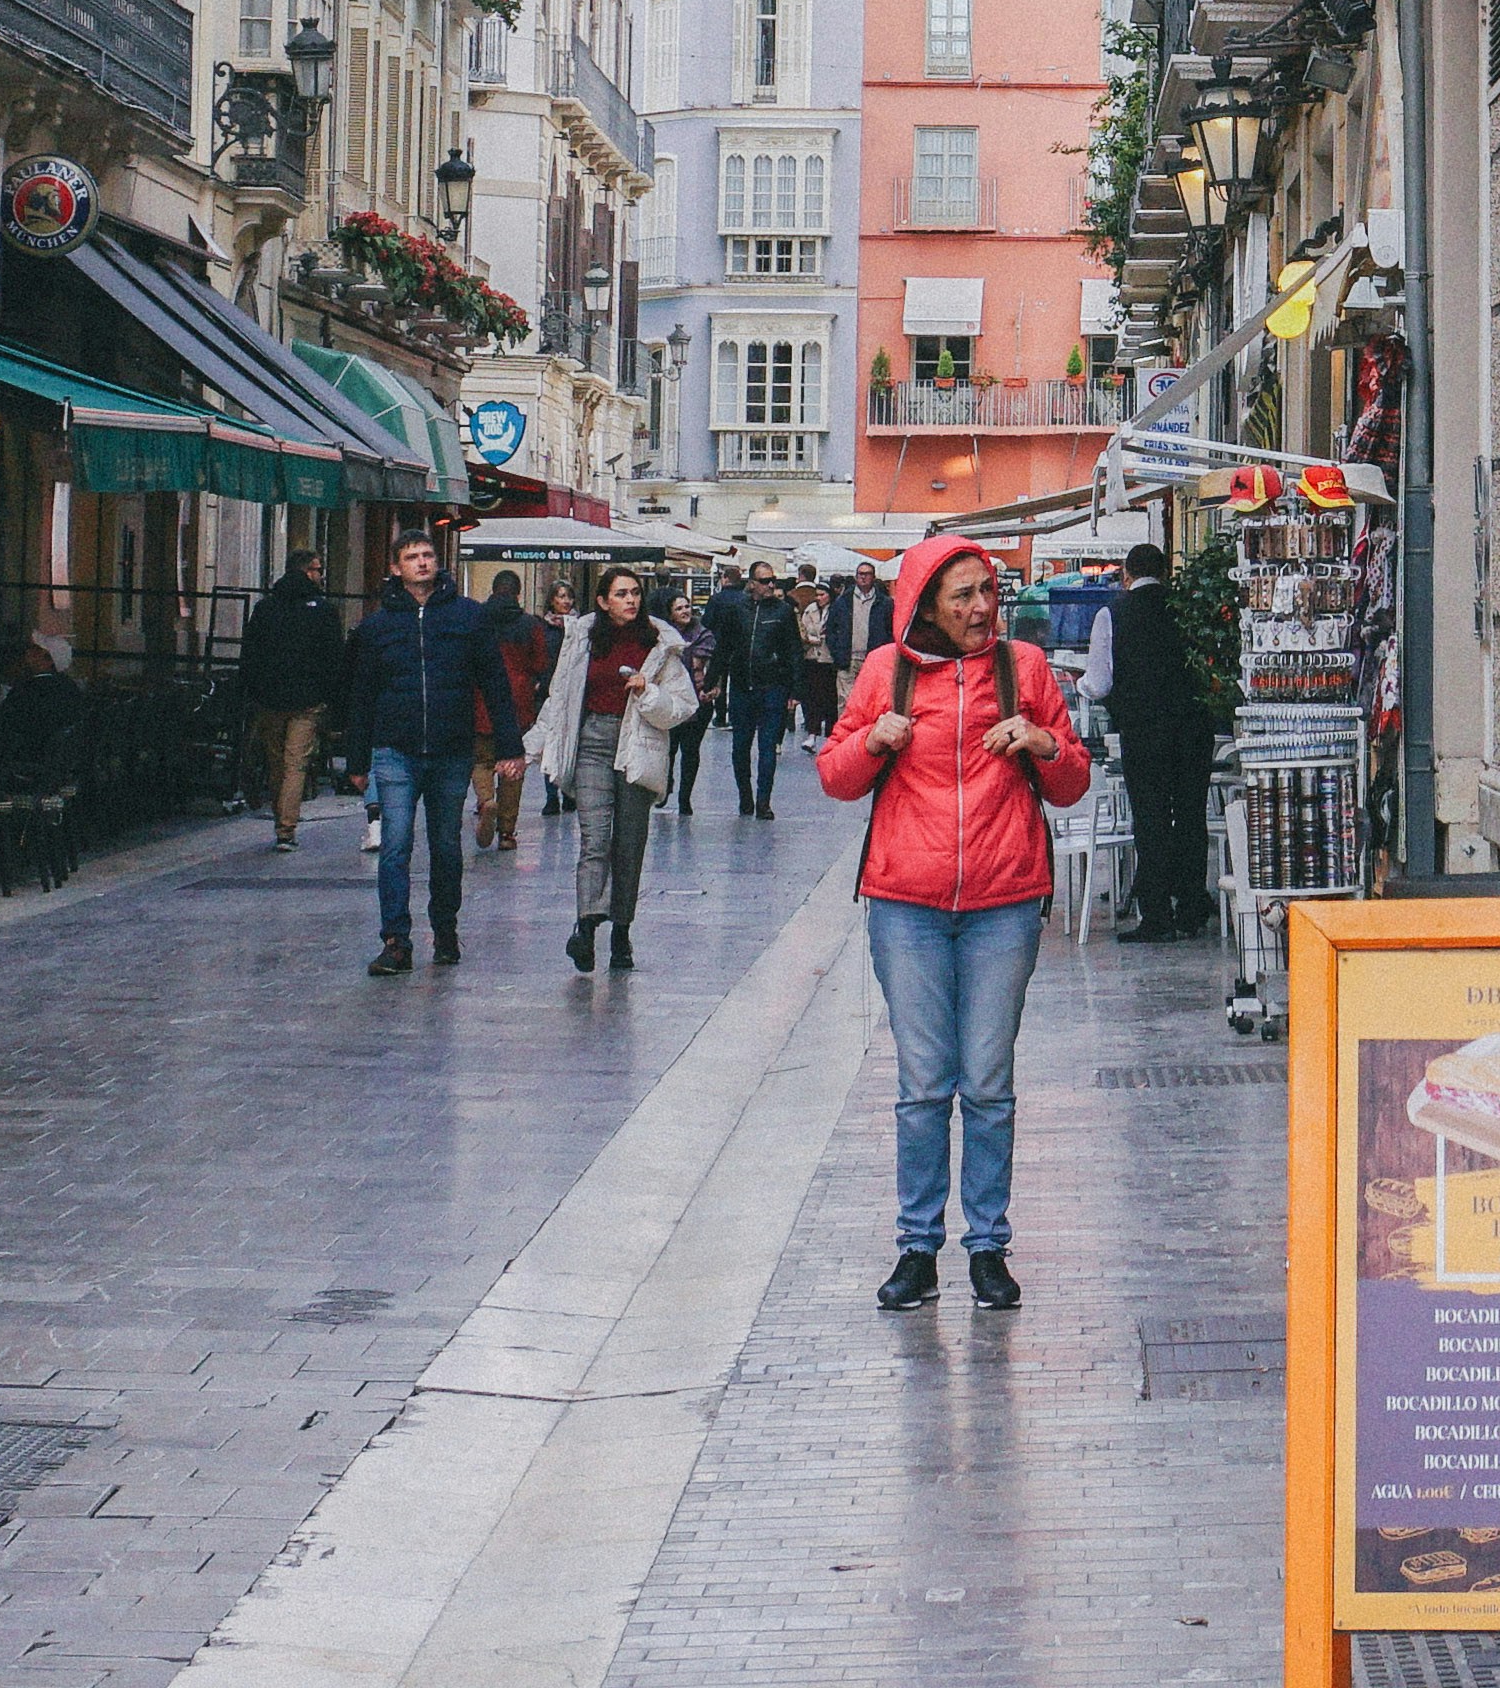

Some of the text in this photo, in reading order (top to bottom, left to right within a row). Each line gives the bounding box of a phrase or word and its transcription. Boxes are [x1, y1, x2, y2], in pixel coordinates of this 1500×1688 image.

[7, 162, 90, 201] PAULANER
[478, 411, 508, 425] BREW
[483, 424, 503, 436] DOG
[513, 550, 546, 560] museo
[573, 549, 612, 561] Ginebra
[1386, 1395, 1478, 1411] BOCADILLO
[1371, 1483, 1413, 1499] AGUA
